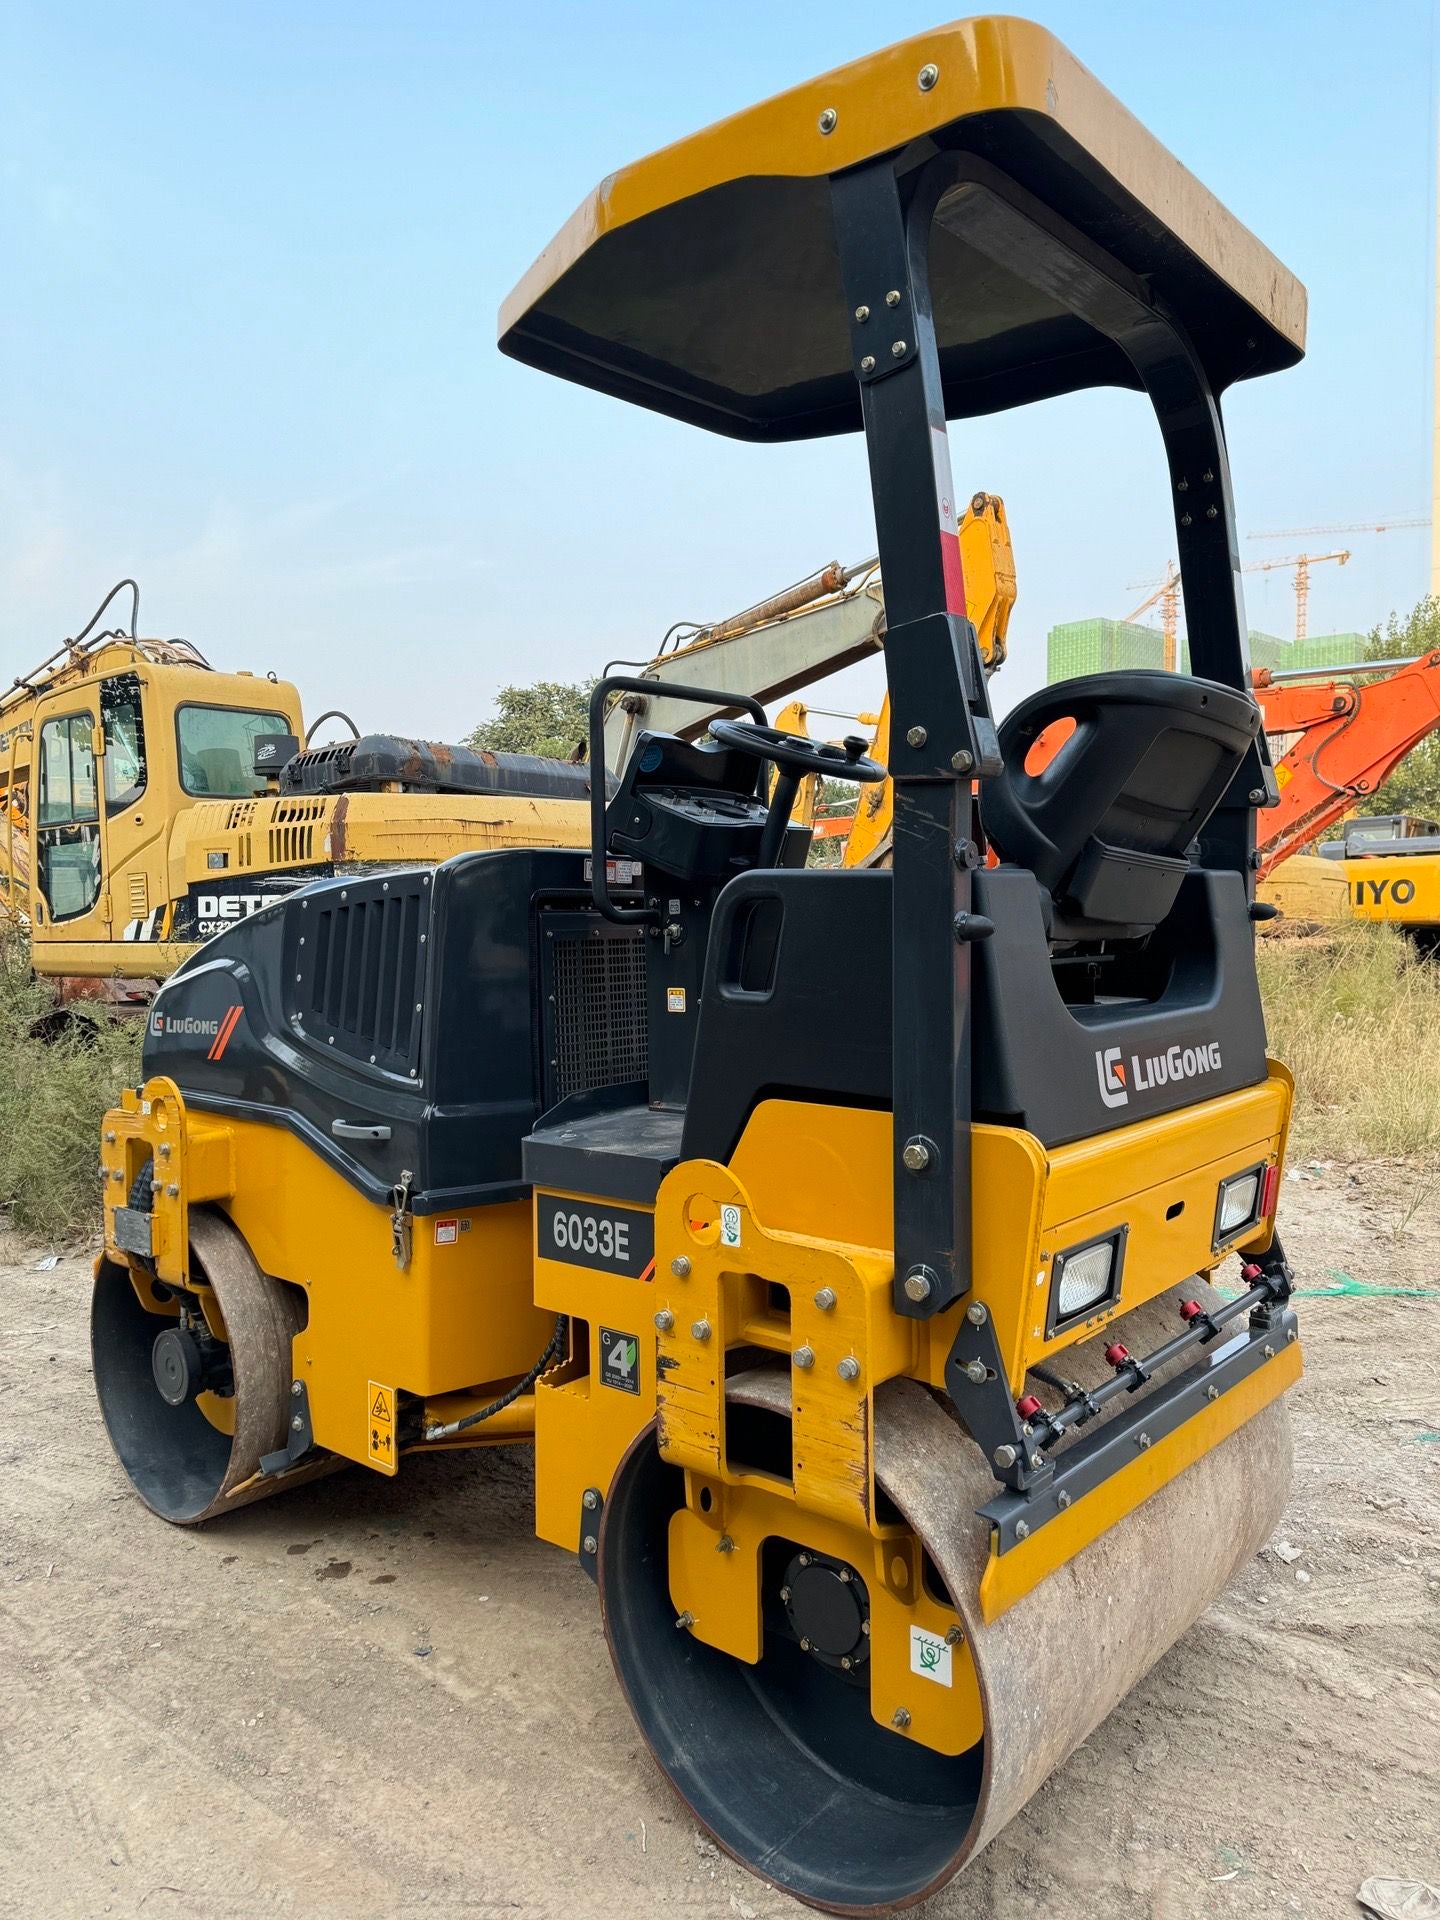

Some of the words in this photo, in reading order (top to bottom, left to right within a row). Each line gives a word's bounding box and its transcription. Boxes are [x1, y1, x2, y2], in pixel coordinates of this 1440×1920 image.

[1348, 879, 1415, 905] IYO
[553, 1211, 630, 1261] 6033E
[602, 1332, 611, 1345] G
[608, 1339, 631, 1378] 4
